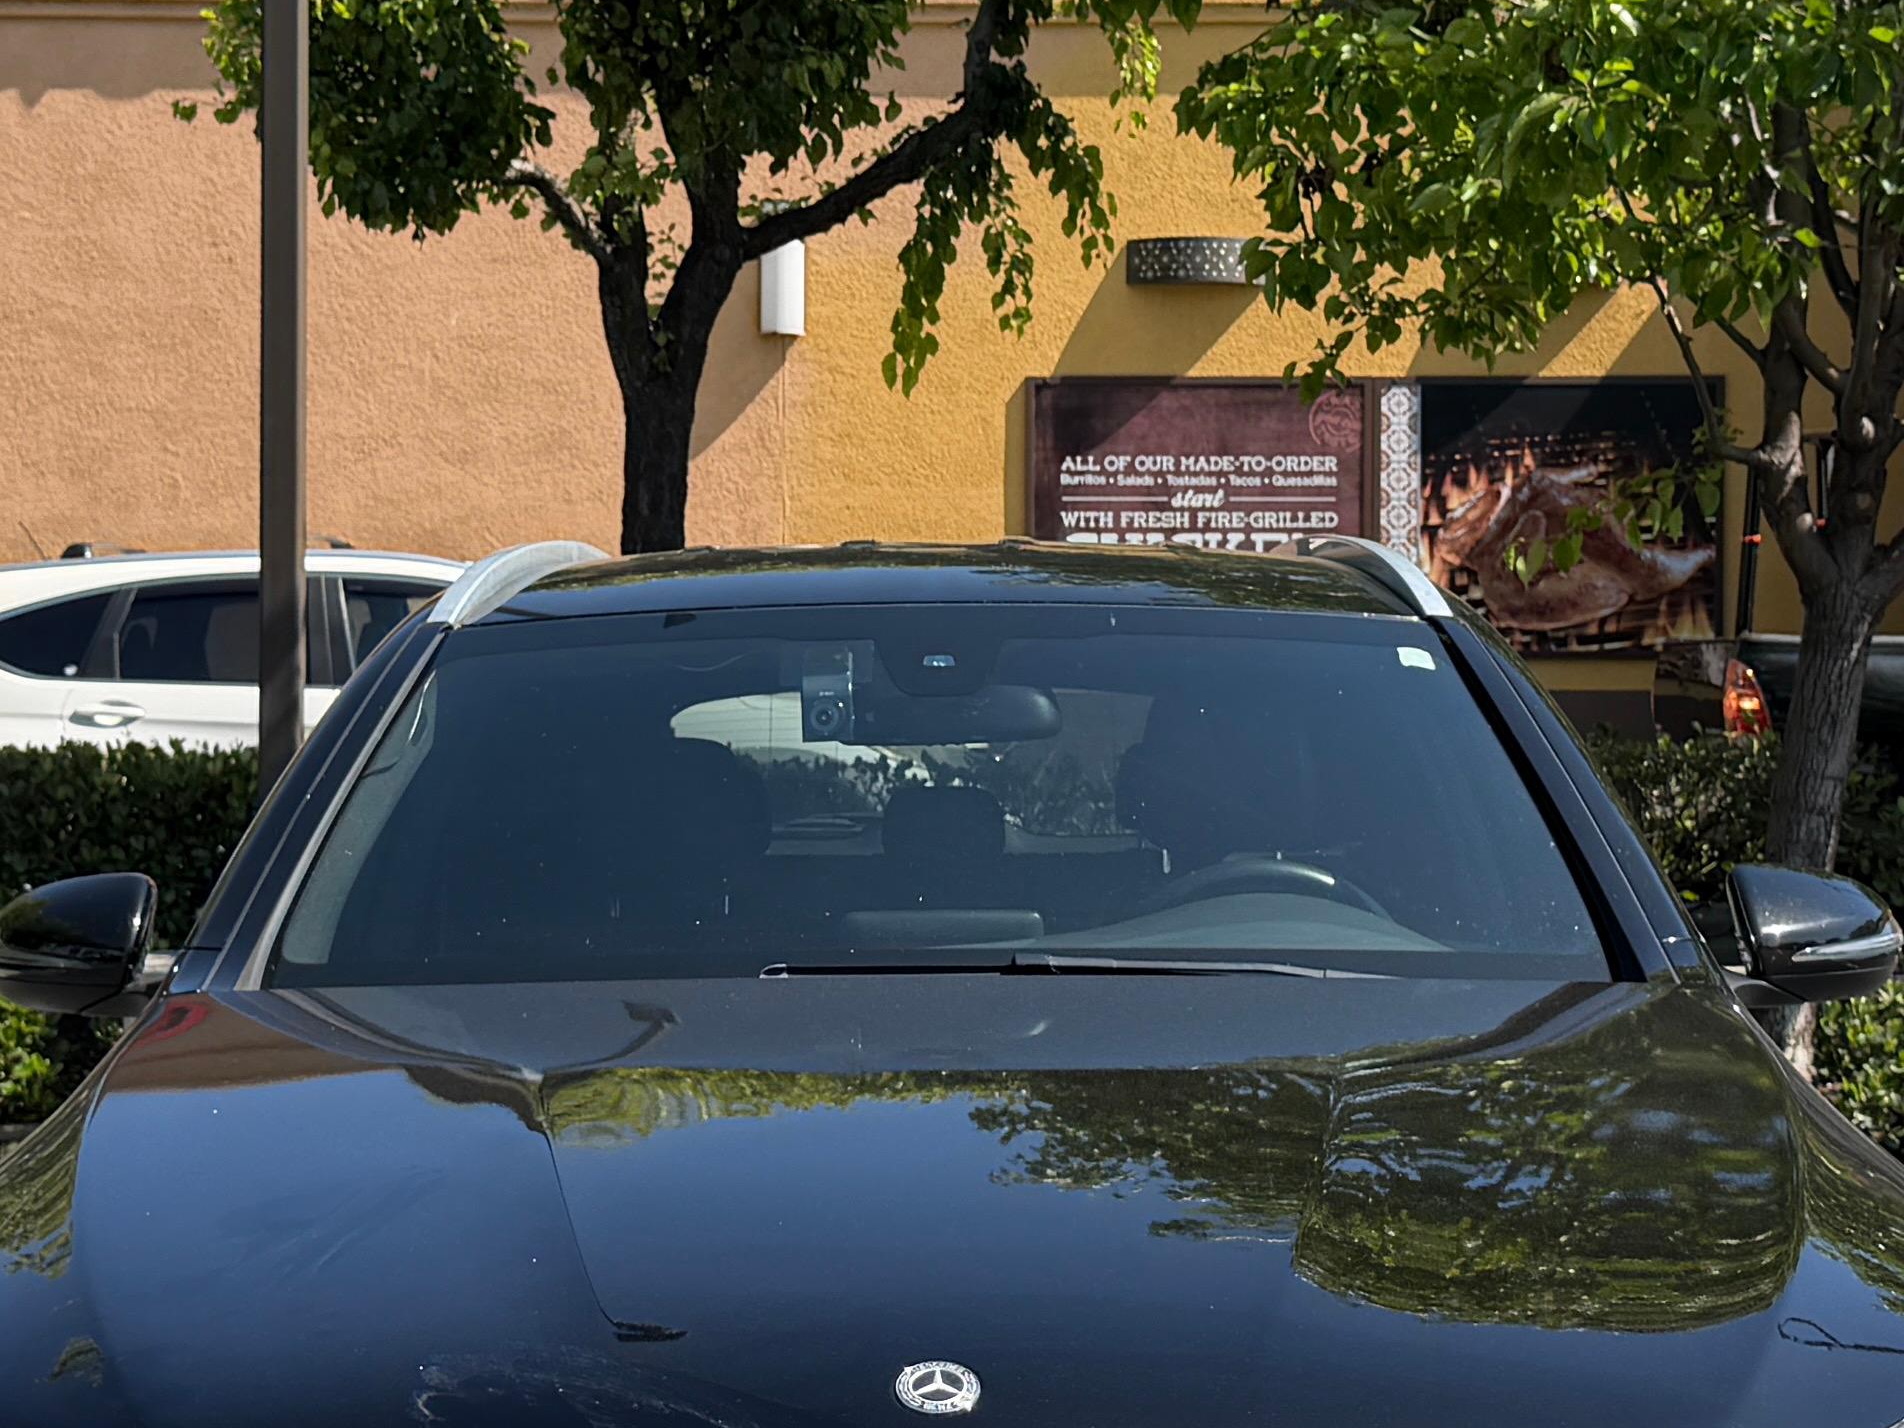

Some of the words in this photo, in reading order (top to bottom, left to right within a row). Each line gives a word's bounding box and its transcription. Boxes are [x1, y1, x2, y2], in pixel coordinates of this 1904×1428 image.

[1060, 455, 1100, 472] ALL
[1103, 455, 1132, 472] OF
[1134, 455, 1175, 472] OUR
[1180, 455, 1338, 472] MADE-TO-ORDER
[1060, 473, 1106, 486] Burritos
[1116, 474, 1154, 486] Salads
[1166, 474, 1217, 486] Tostadas
[1228, 474, 1261, 486] Tacos
[1272, 474, 1338, 487] Quesadillas
[1170, 488, 1225, 508] start
[1060, 511, 1114, 528] WITH
[1120, 511, 1190, 528] FRESH
[1197, 511, 1339, 528] FIRE-GRILLED
